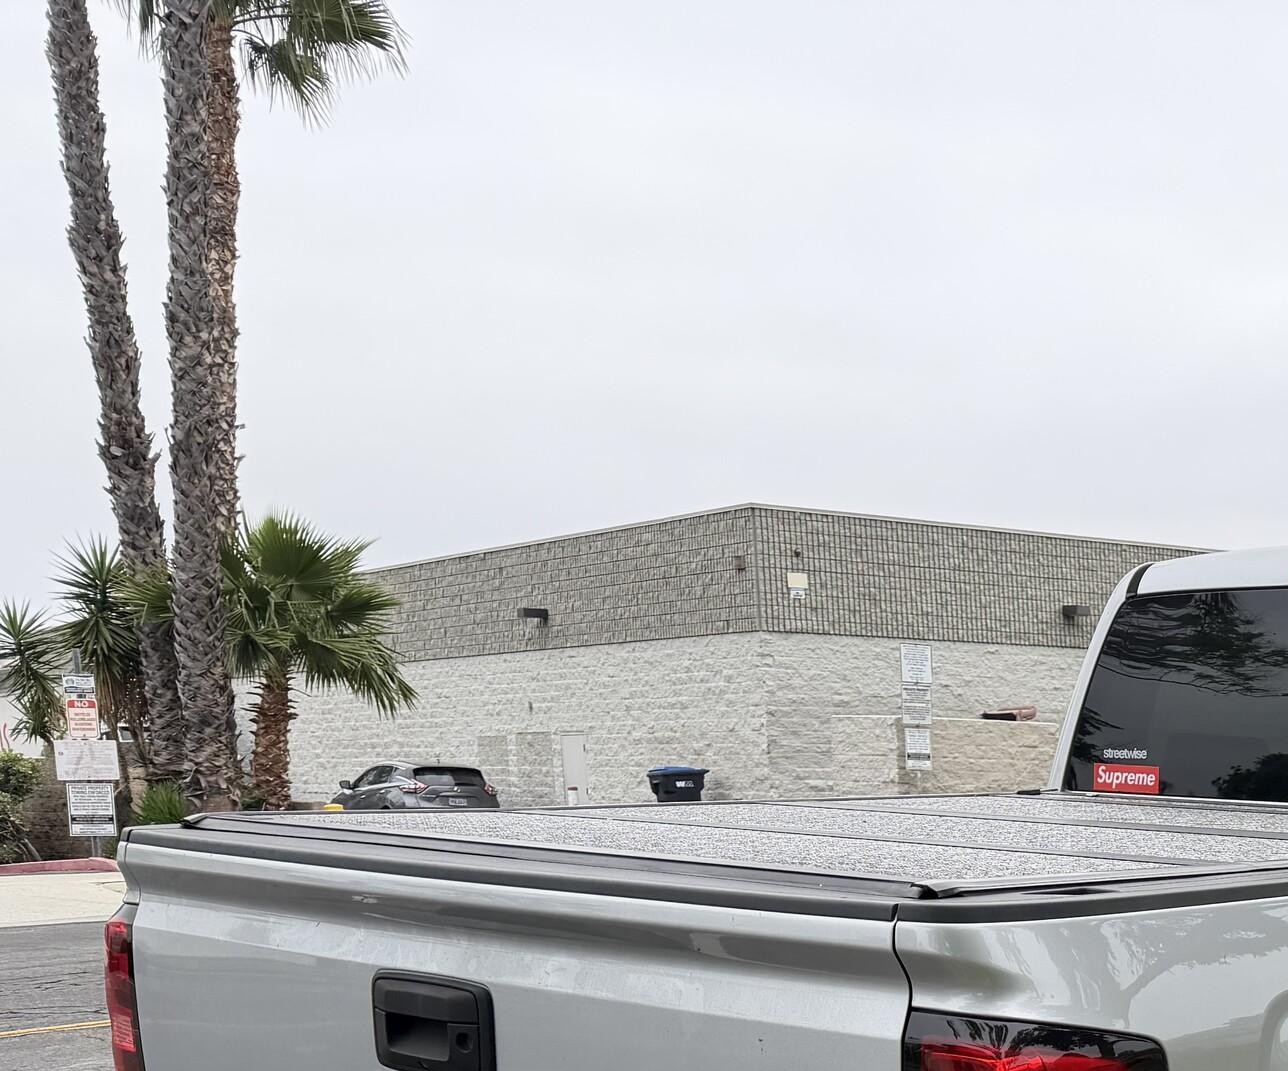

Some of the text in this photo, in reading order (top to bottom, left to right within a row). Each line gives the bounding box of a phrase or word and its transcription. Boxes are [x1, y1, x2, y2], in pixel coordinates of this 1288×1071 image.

[74, 700, 89, 708] NO
[1103, 748, 1148, 760] streetwise
[1097, 765, 1156, 789] Supreme
